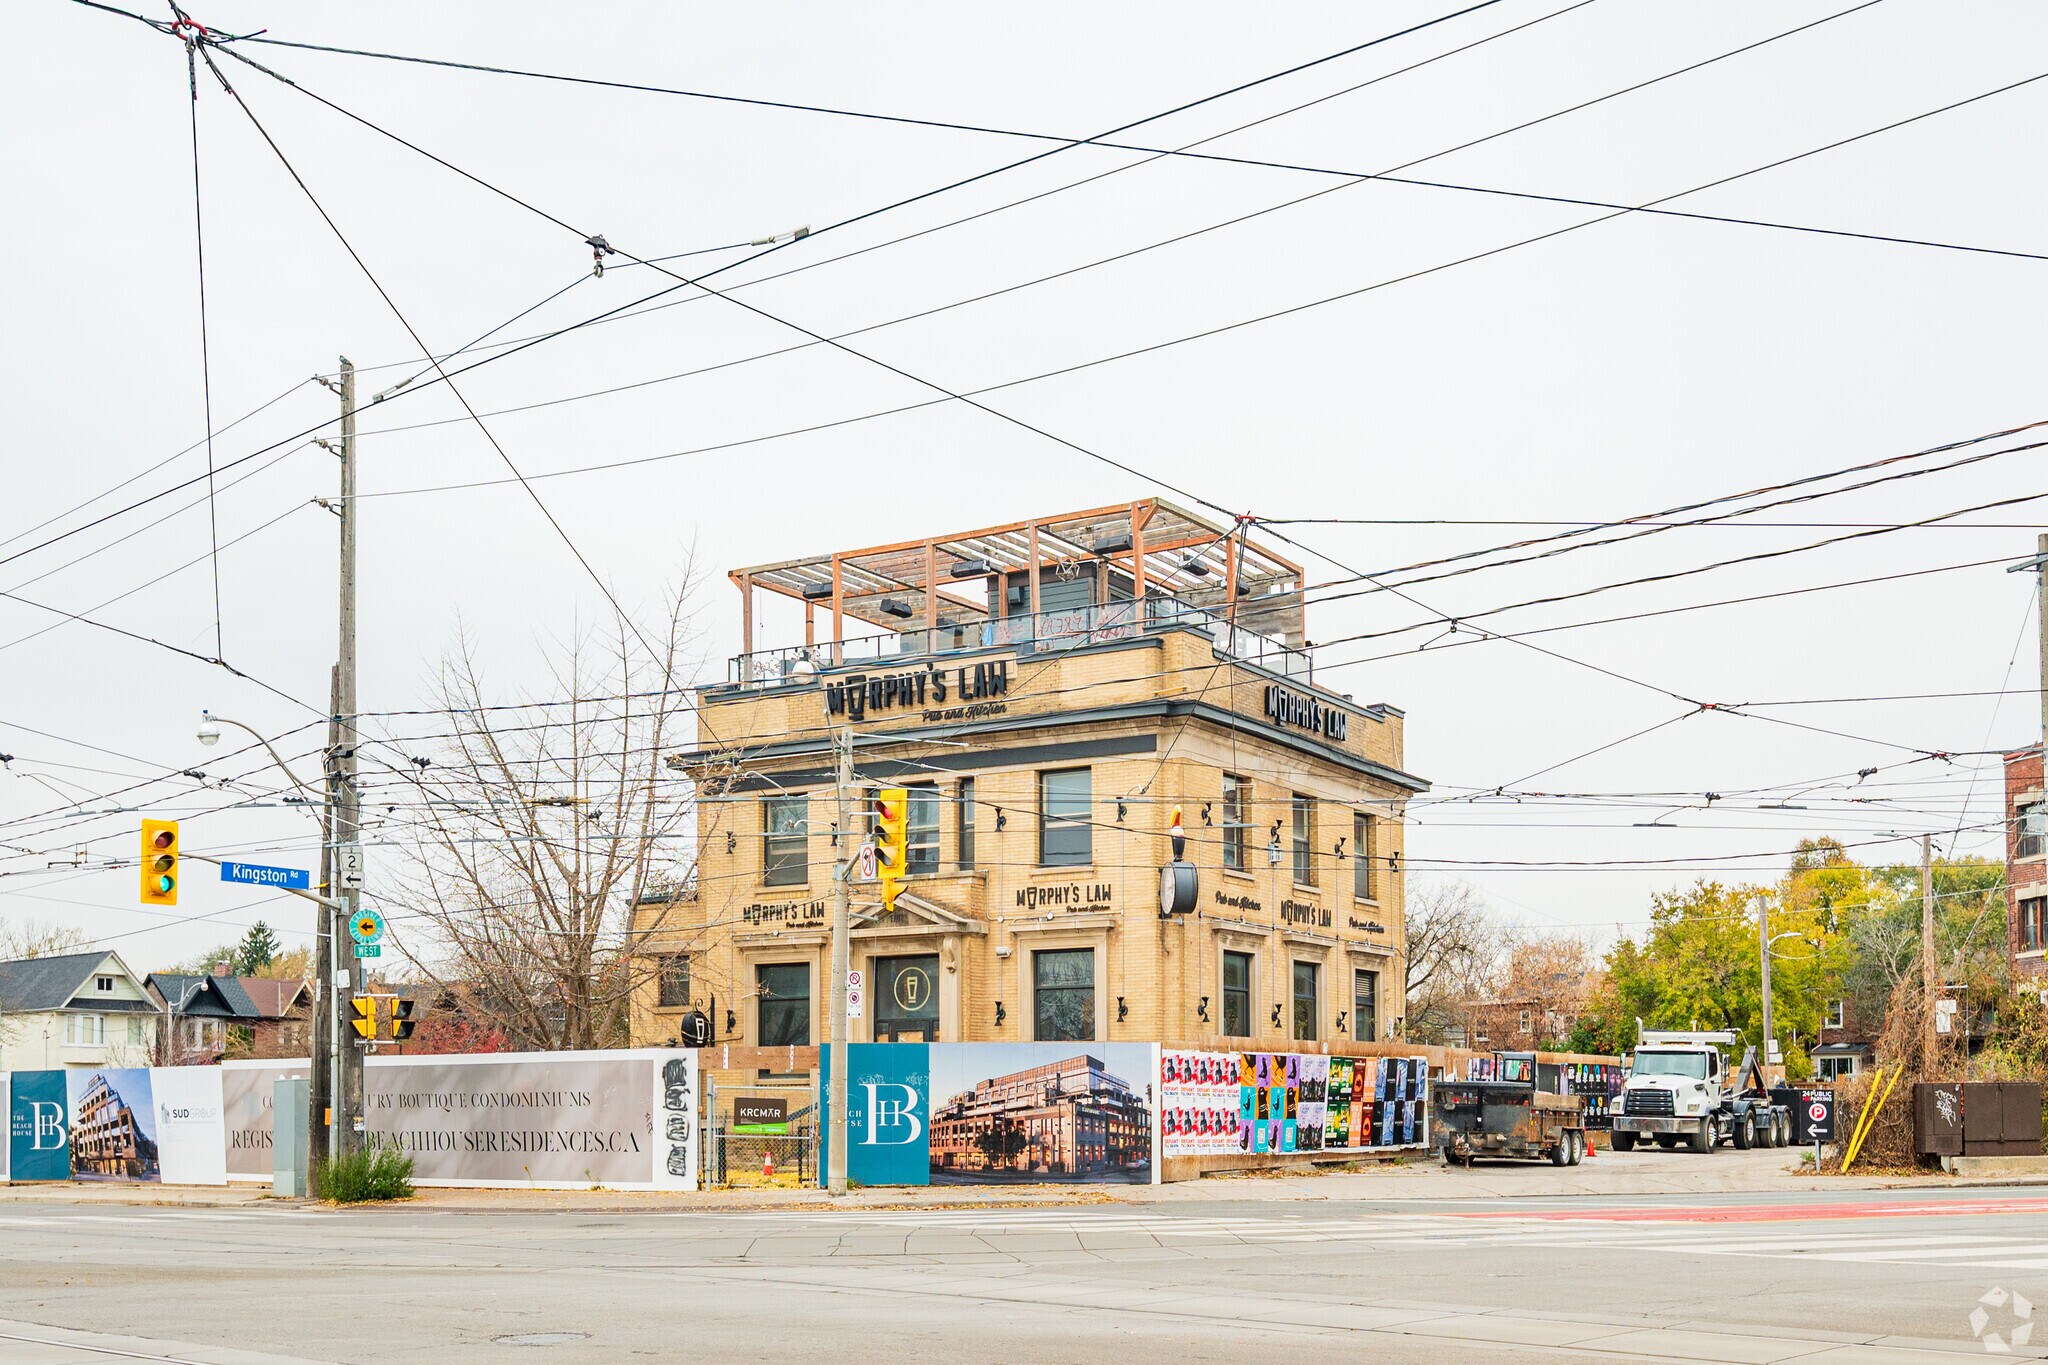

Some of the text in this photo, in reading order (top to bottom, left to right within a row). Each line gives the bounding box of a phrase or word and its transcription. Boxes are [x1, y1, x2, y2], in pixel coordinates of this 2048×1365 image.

[958, 660, 1007, 699] LAW
[922, 703, 1008, 722] Pub and Kitchen
[1324, 707, 1348, 741] LAW
[348, 855, 356, 868] 2
[232, 863, 299, 884] Kingston Rd
[1086, 884, 1111, 902] LAW
[803, 902, 825, 919] LAW
[1318, 908, 1332, 927] LAW
[358, 946, 377, 956] WEST
[367, 1092, 591, 1112] URY BOUTIQUE CONDOMINIUMS
[740, 1107, 781, 1118] KRCMAR
[232, 1130, 273, 1149] REGIS
